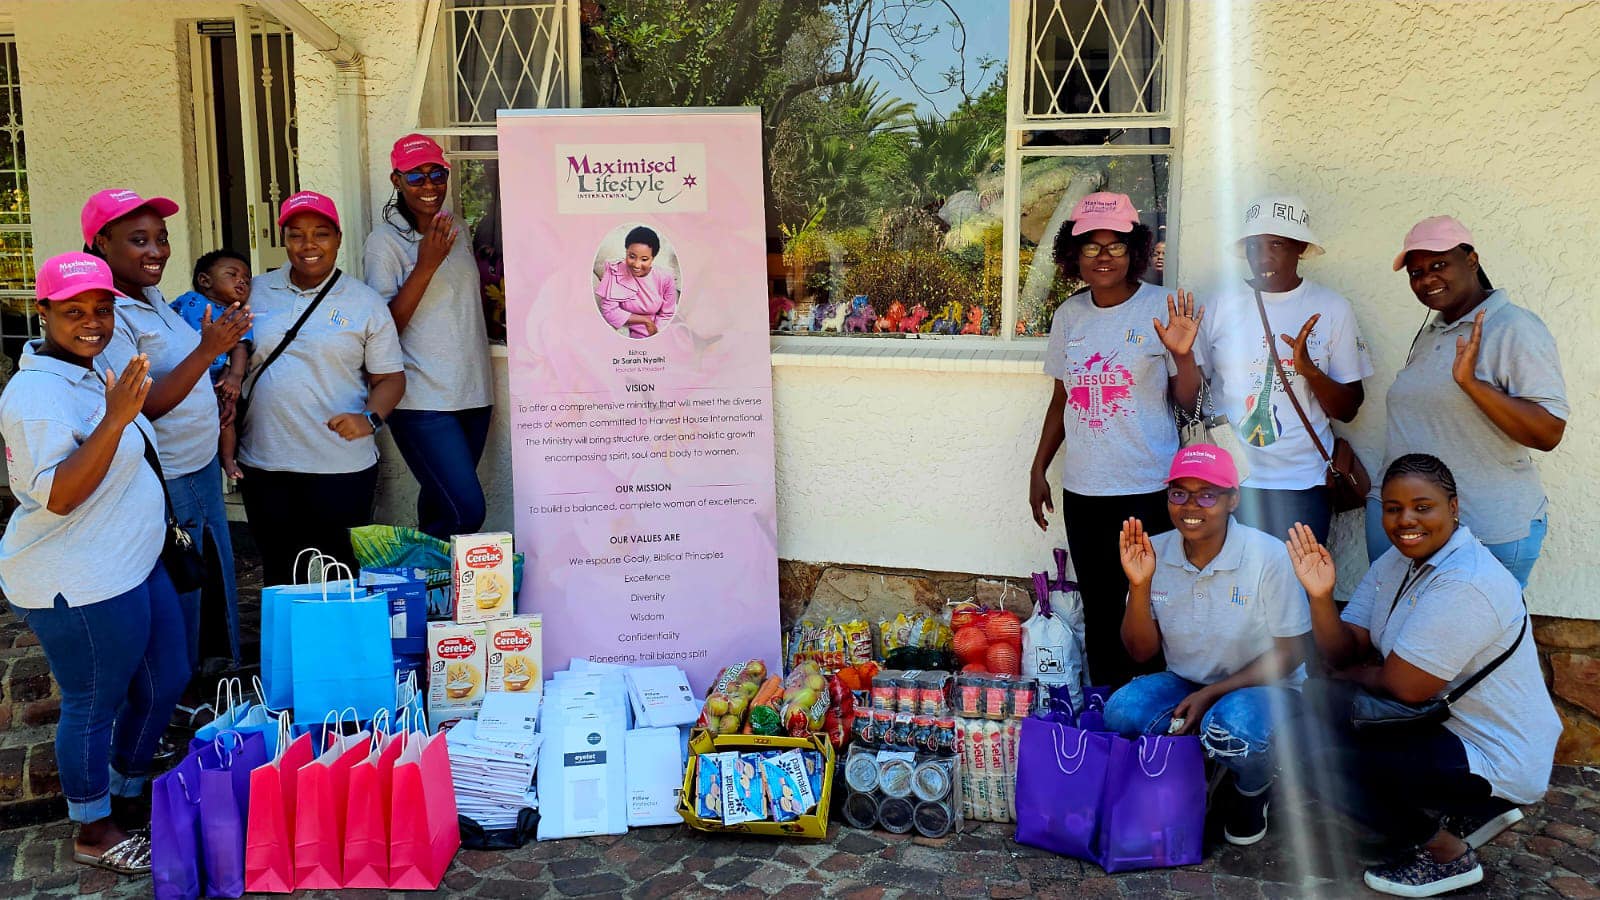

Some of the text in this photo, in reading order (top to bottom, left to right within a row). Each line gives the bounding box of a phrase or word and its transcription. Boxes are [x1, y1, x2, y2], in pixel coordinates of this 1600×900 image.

[566, 154, 677, 176] Maximised
[578, 173, 665, 201] Lifestyle
[621, 357, 642, 365] Sarah
[643, 355, 666, 365] Nyathi
[1077, 373, 1116, 386] JESUS
[625, 384, 655, 392] VISION
[519, 404, 528, 413] To
[529, 403, 549, 413] offer
[558, 401, 625, 413] comprehensive
[626, 399, 658, 410] ministry
[659, 399, 676, 409] that
[678, 399, 691, 407] will
[693, 398, 715, 407] meet
[717, 398, 731, 406] the
[732, 396, 762, 405] diverse
[517, 420, 543, 430] needs
[543, 419, 553, 429] of
[554, 420, 588, 429] women
[589, 417, 637, 428] committed
[639, 417, 648, 426] to
[649, 416, 681, 425] Harvest
[682, 414, 709, 424] House
[525, 438, 541, 447] The
[542, 436, 573, 447] Ministry
[574, 435, 588, 445] will
[588, 435, 612, 446] bring
[653, 431, 677, 442] order
[678, 432, 696, 441] and
[697, 431, 726, 440] holistic
[727, 430, 756, 441] growth
[544, 446, 740, 464] encompassing spirit, soul and body to women.
[615, 482, 672, 494] OUR MISSION
[529, 505, 539, 515] To
[540, 503, 562, 514] build
[572, 503, 618, 513] balanced,
[619, 501, 661, 512] complete
[663, 499, 696, 509] woman
[697, 498, 707, 507] of
[708, 496, 757, 507] excellence.
[609, 533, 681, 545] OUR VALUES ARE
[466, 552, 501, 564] Cerelac
[569, 557, 584, 566] We
[585, 556, 621, 567] espouse
[653, 551, 683, 563] Biblical
[685, 550, 724, 562] Principles
[624, 573, 671, 583] Excellence
[630, 592, 666, 602] Diversity
[630, 612, 665, 621] Wisdom
[495, 635, 530, 646] Cerelac
[617, 631, 681, 642] Confidentiality
[438, 643, 473, 654] Cerelac
[589, 648, 708, 664] Pioneering, trail blazing spirit
[973, 743, 985, 769] Selati
[991, 742, 1003, 769] Selati
[789, 757, 809, 796] parmalat
[725, 774, 737, 816] parmalat
